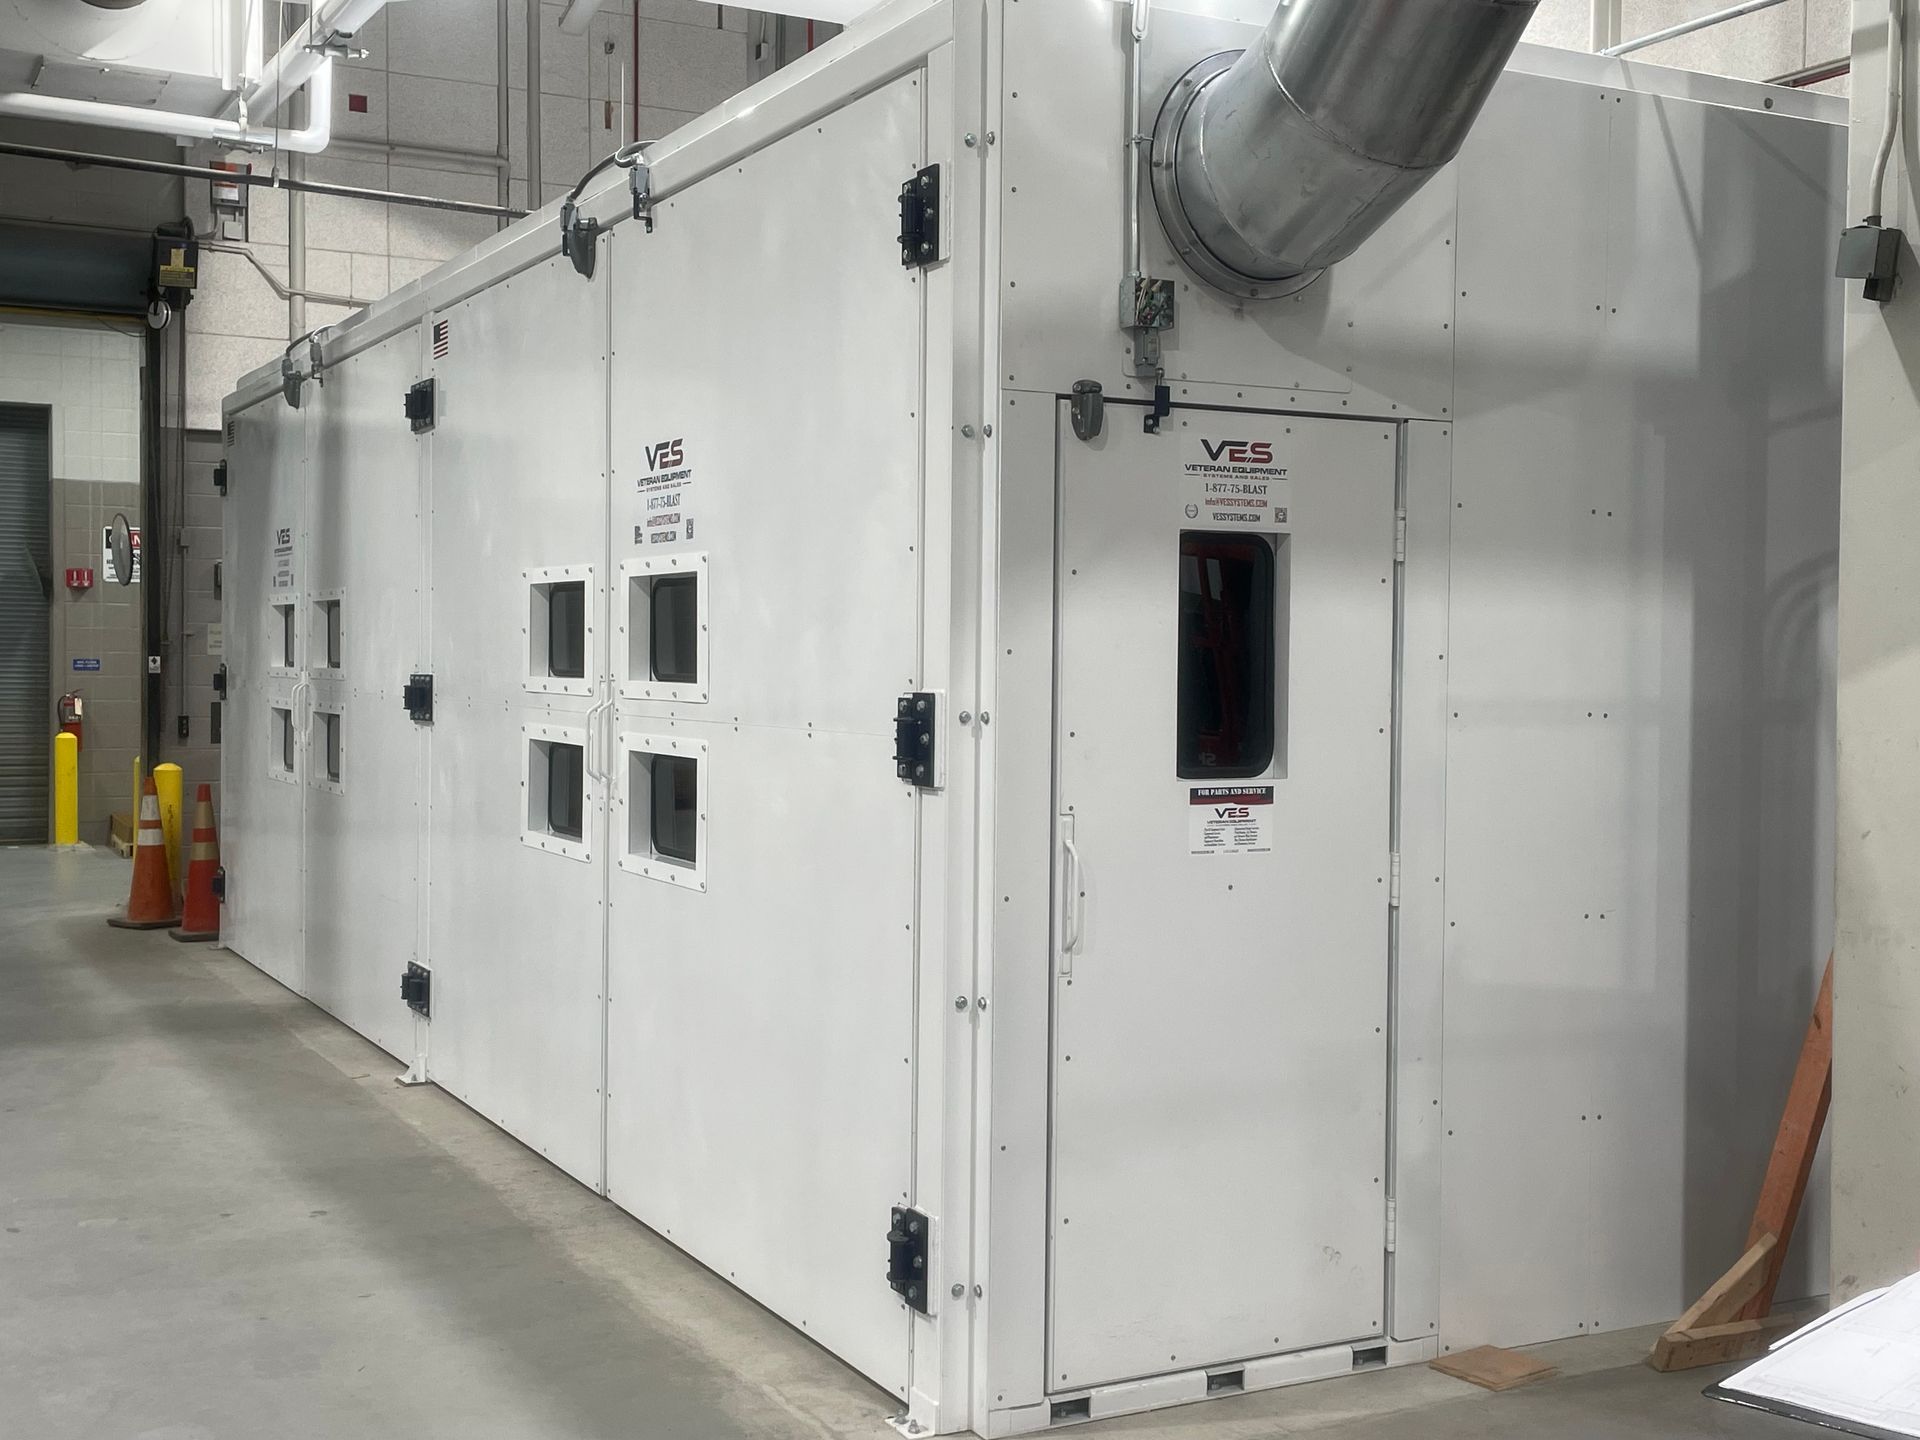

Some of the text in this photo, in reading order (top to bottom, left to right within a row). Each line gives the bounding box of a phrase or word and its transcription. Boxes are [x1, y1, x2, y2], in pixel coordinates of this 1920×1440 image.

[645, 438, 683, 471] VES
[1200, 439, 1273, 464] VES
[1185, 464, 1287, 475] VETERAN EQUIPMENT
[637, 469, 692, 487] VETERAN EQUIPMENT
[1205, 483, 1267, 495] 1-877-75-BLAST
[1212, 513, 1260, 522] VESSYSTEMS.COM
[277, 528, 290, 545] VES
[1215, 808, 1249, 818] VES
